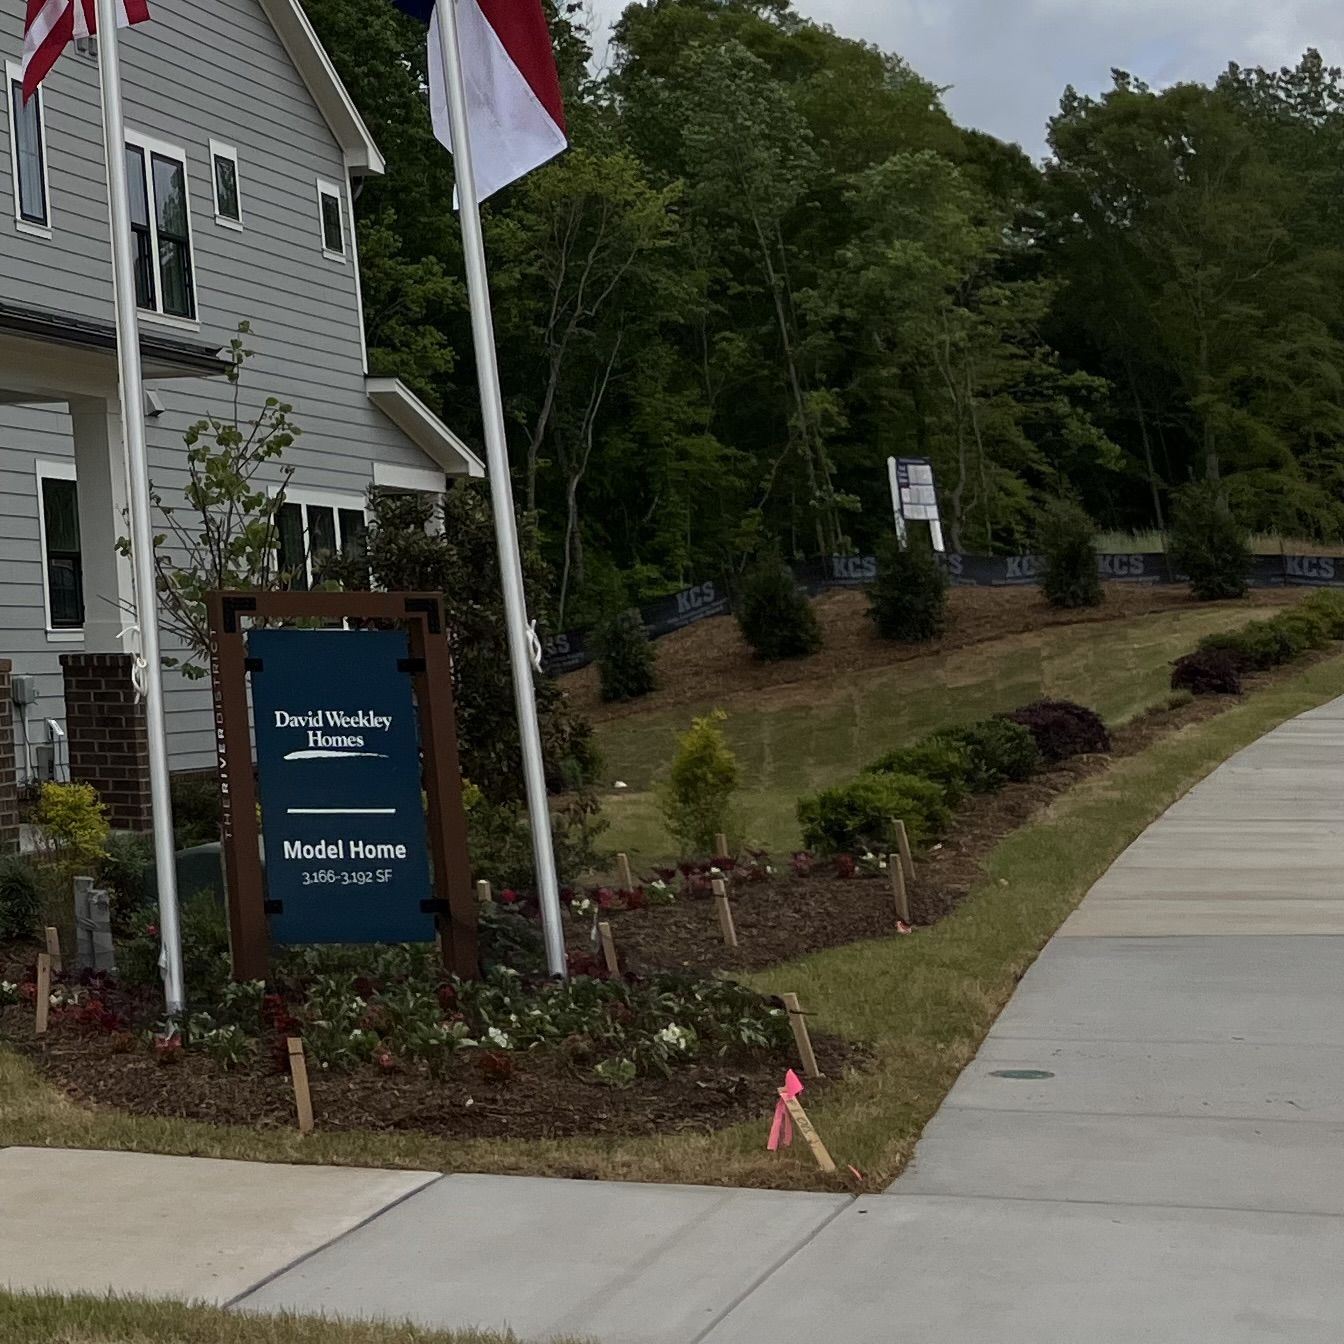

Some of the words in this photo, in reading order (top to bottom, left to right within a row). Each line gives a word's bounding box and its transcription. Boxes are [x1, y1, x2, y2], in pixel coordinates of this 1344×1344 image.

[832, 556, 877, 578] KCS
[1285, 556, 1336, 580] KCS
[676, 581, 716, 614] KCS
[274, 710, 324, 728] David
[325, 710, 393, 732] Weekley
[307, 730, 365, 748] Homes
[283, 839, 344, 860] Model
[349, 840, 407, 859] Home
[375, 869, 393, 883] SF
